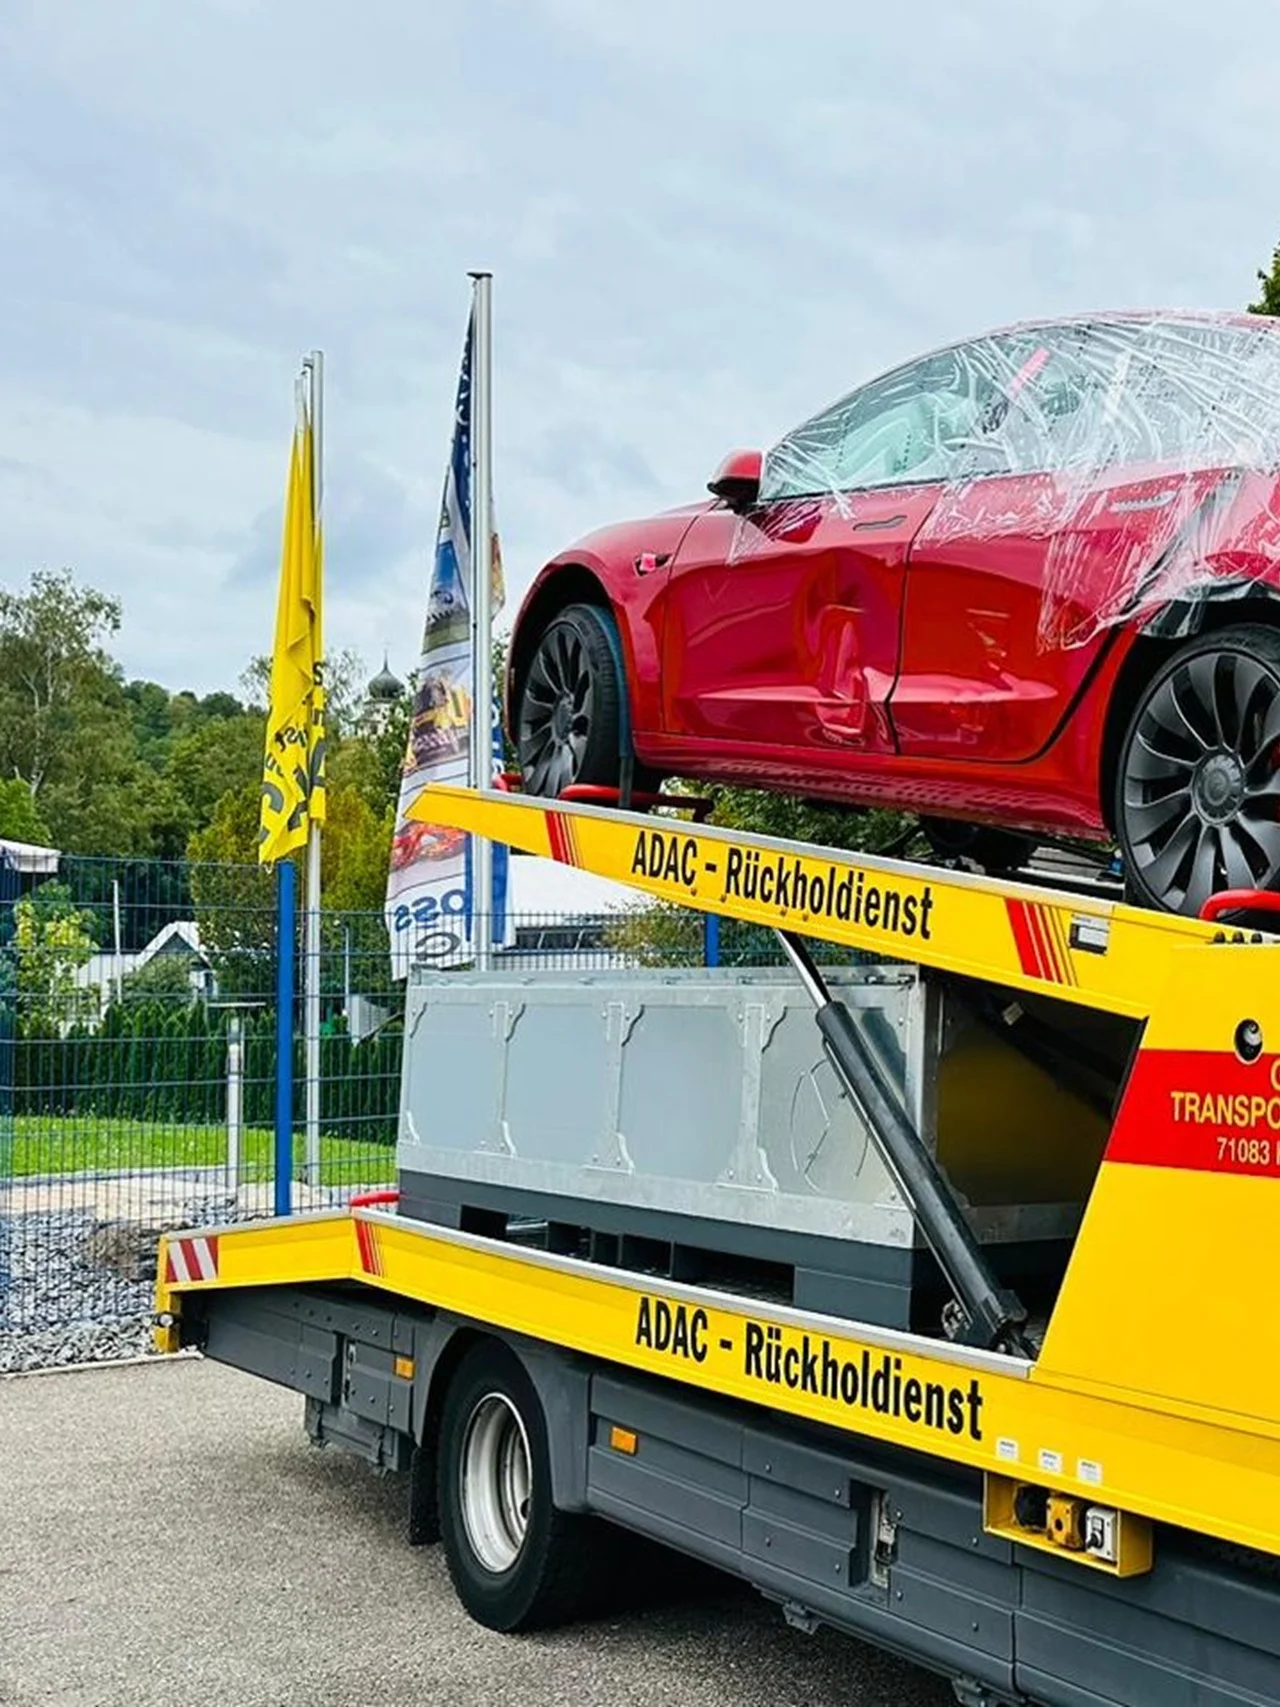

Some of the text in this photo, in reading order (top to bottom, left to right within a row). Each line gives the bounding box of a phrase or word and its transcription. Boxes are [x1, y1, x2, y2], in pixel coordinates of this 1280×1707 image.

[631, 831, 697, 887] ADAC
[725, 846, 934, 941] Rückholdienst
[1216, 1136, 1271, 1166] 71083
[636, 1297, 709, 1364] ADAC
[745, 1321, 983, 1442] Rückholdienst
